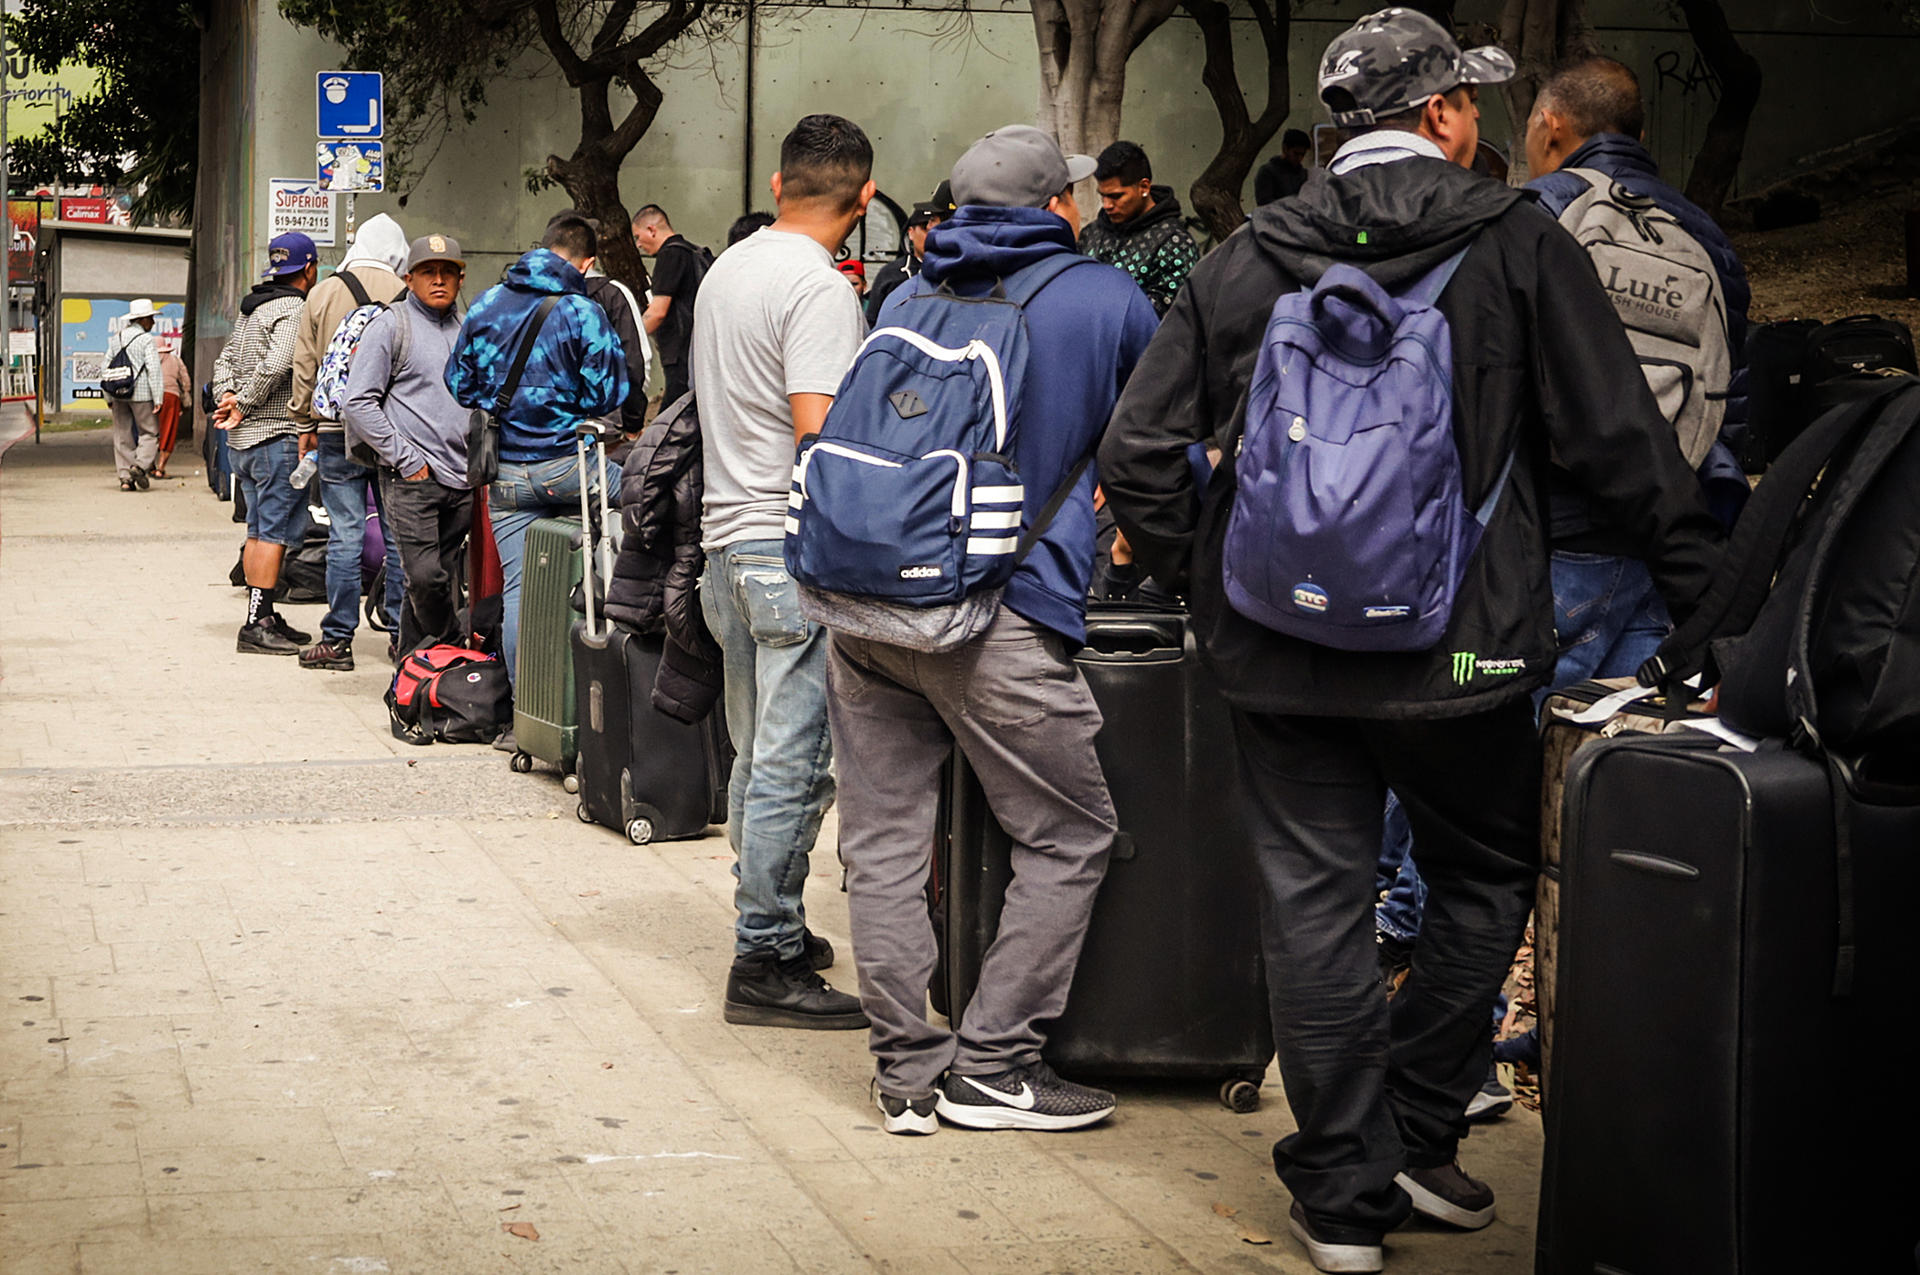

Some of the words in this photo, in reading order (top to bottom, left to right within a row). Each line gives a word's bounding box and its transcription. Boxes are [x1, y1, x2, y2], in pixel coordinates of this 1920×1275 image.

[275, 189, 329, 208] SUPERIOR
[275, 216, 329, 227] 619-947-2115
[1608, 292, 1632, 308] ISH
[1635, 300, 1681, 322] HOUSE
[900, 566, 942, 579] adidas
[1475, 658, 1527, 669] MONSTER
